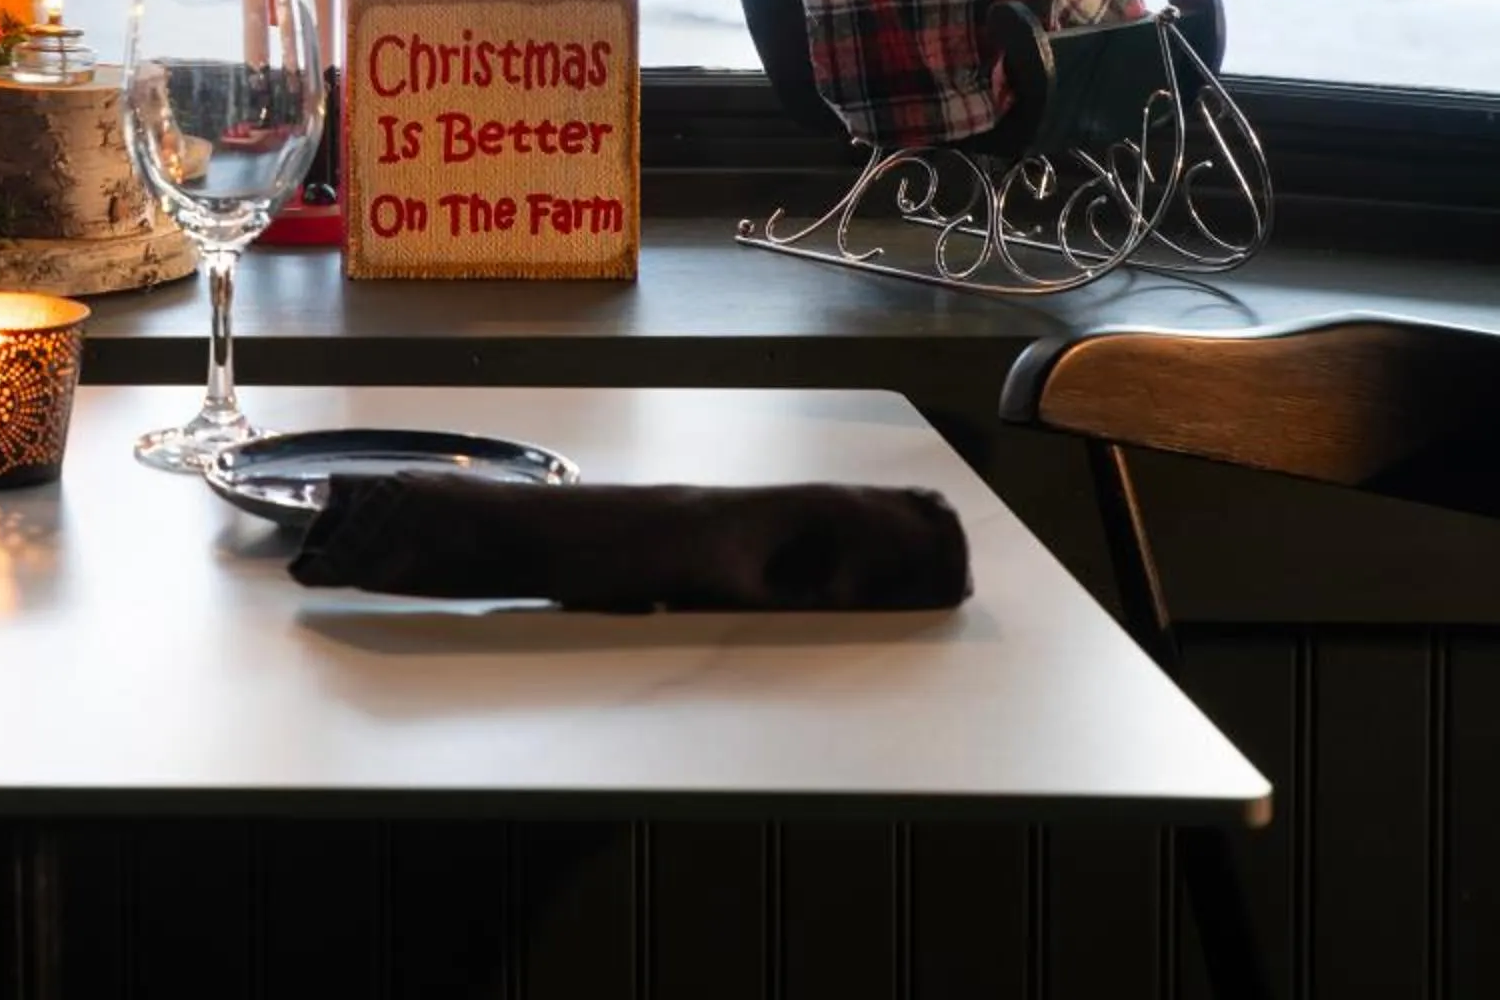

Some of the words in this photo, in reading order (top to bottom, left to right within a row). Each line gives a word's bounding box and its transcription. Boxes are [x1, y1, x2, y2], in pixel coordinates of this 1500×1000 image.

[369, 29, 612, 98] Christmas
[377, 115, 423, 164] Is
[435, 111, 613, 164] Better
[369, 193, 428, 238] On
[439, 191, 518, 236] The
[524, 193, 624, 235] Farm
